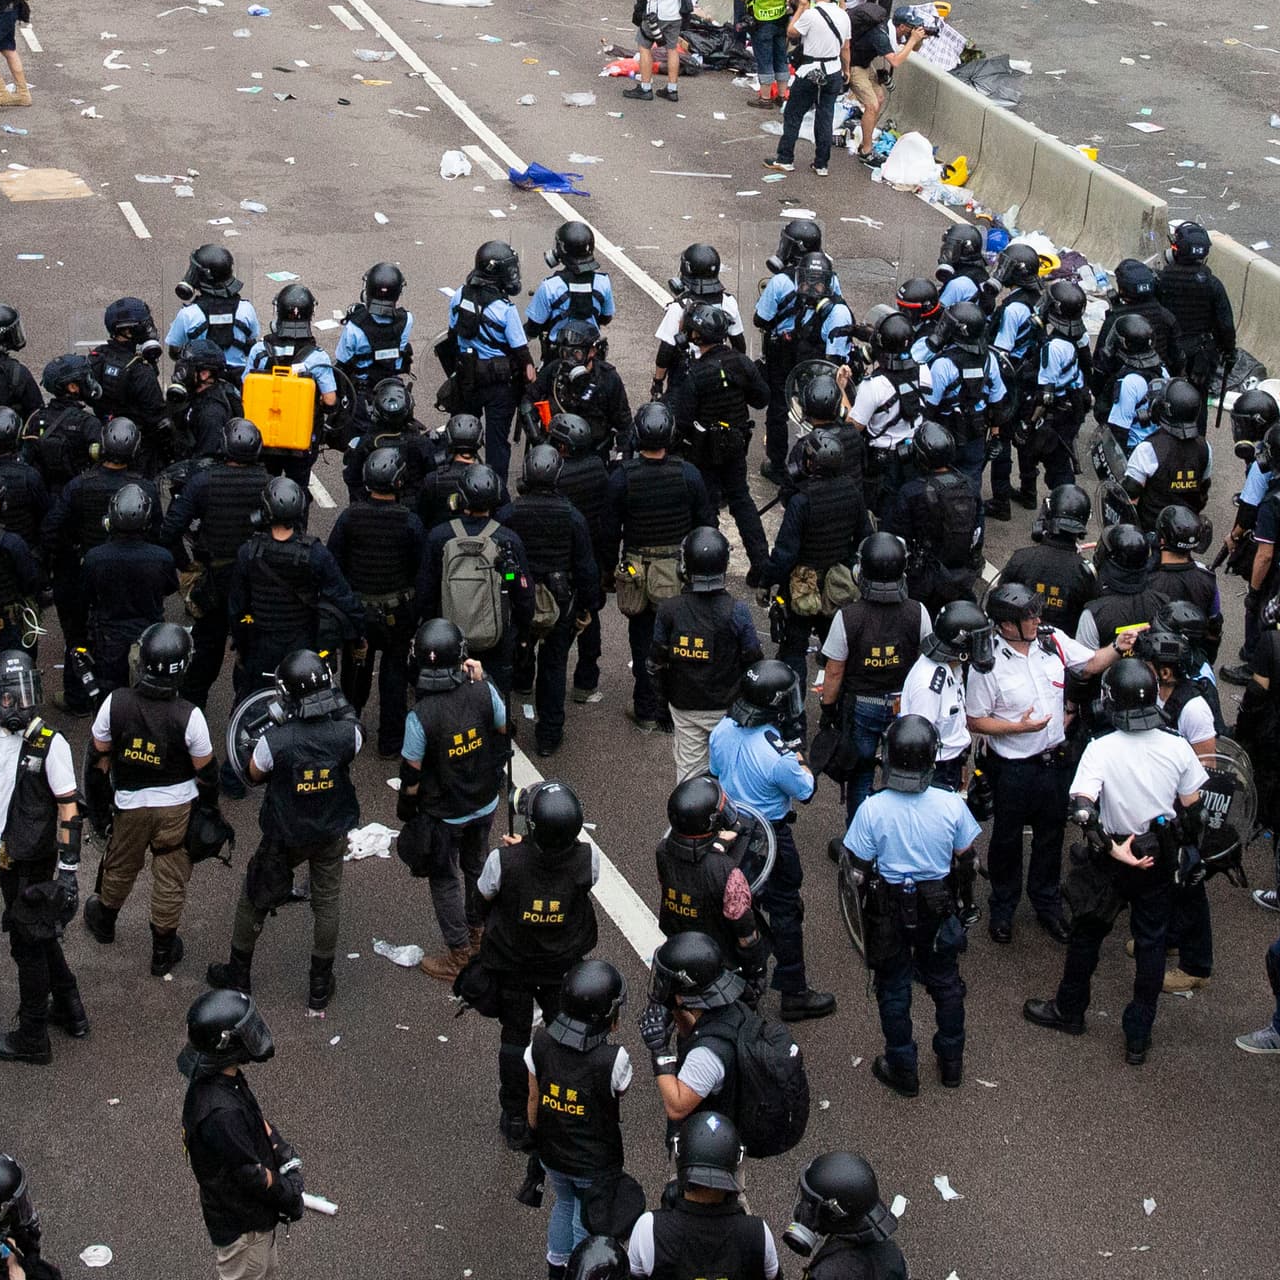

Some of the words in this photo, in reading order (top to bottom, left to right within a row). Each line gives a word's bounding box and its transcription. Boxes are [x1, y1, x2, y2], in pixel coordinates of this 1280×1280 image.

[672, 647, 709, 659] POLICE
[864, 655, 899, 667] POLICE
[168, 658, 185, 674] E1
[448, 738, 482, 757] POLICE
[124, 748, 160, 765] POLICE
[296, 780, 334, 793] POLICE
[663, 898, 697, 919] POLICE
[522, 911, 565, 924] POLICE
[542, 1095, 585, 1116] POLICE
